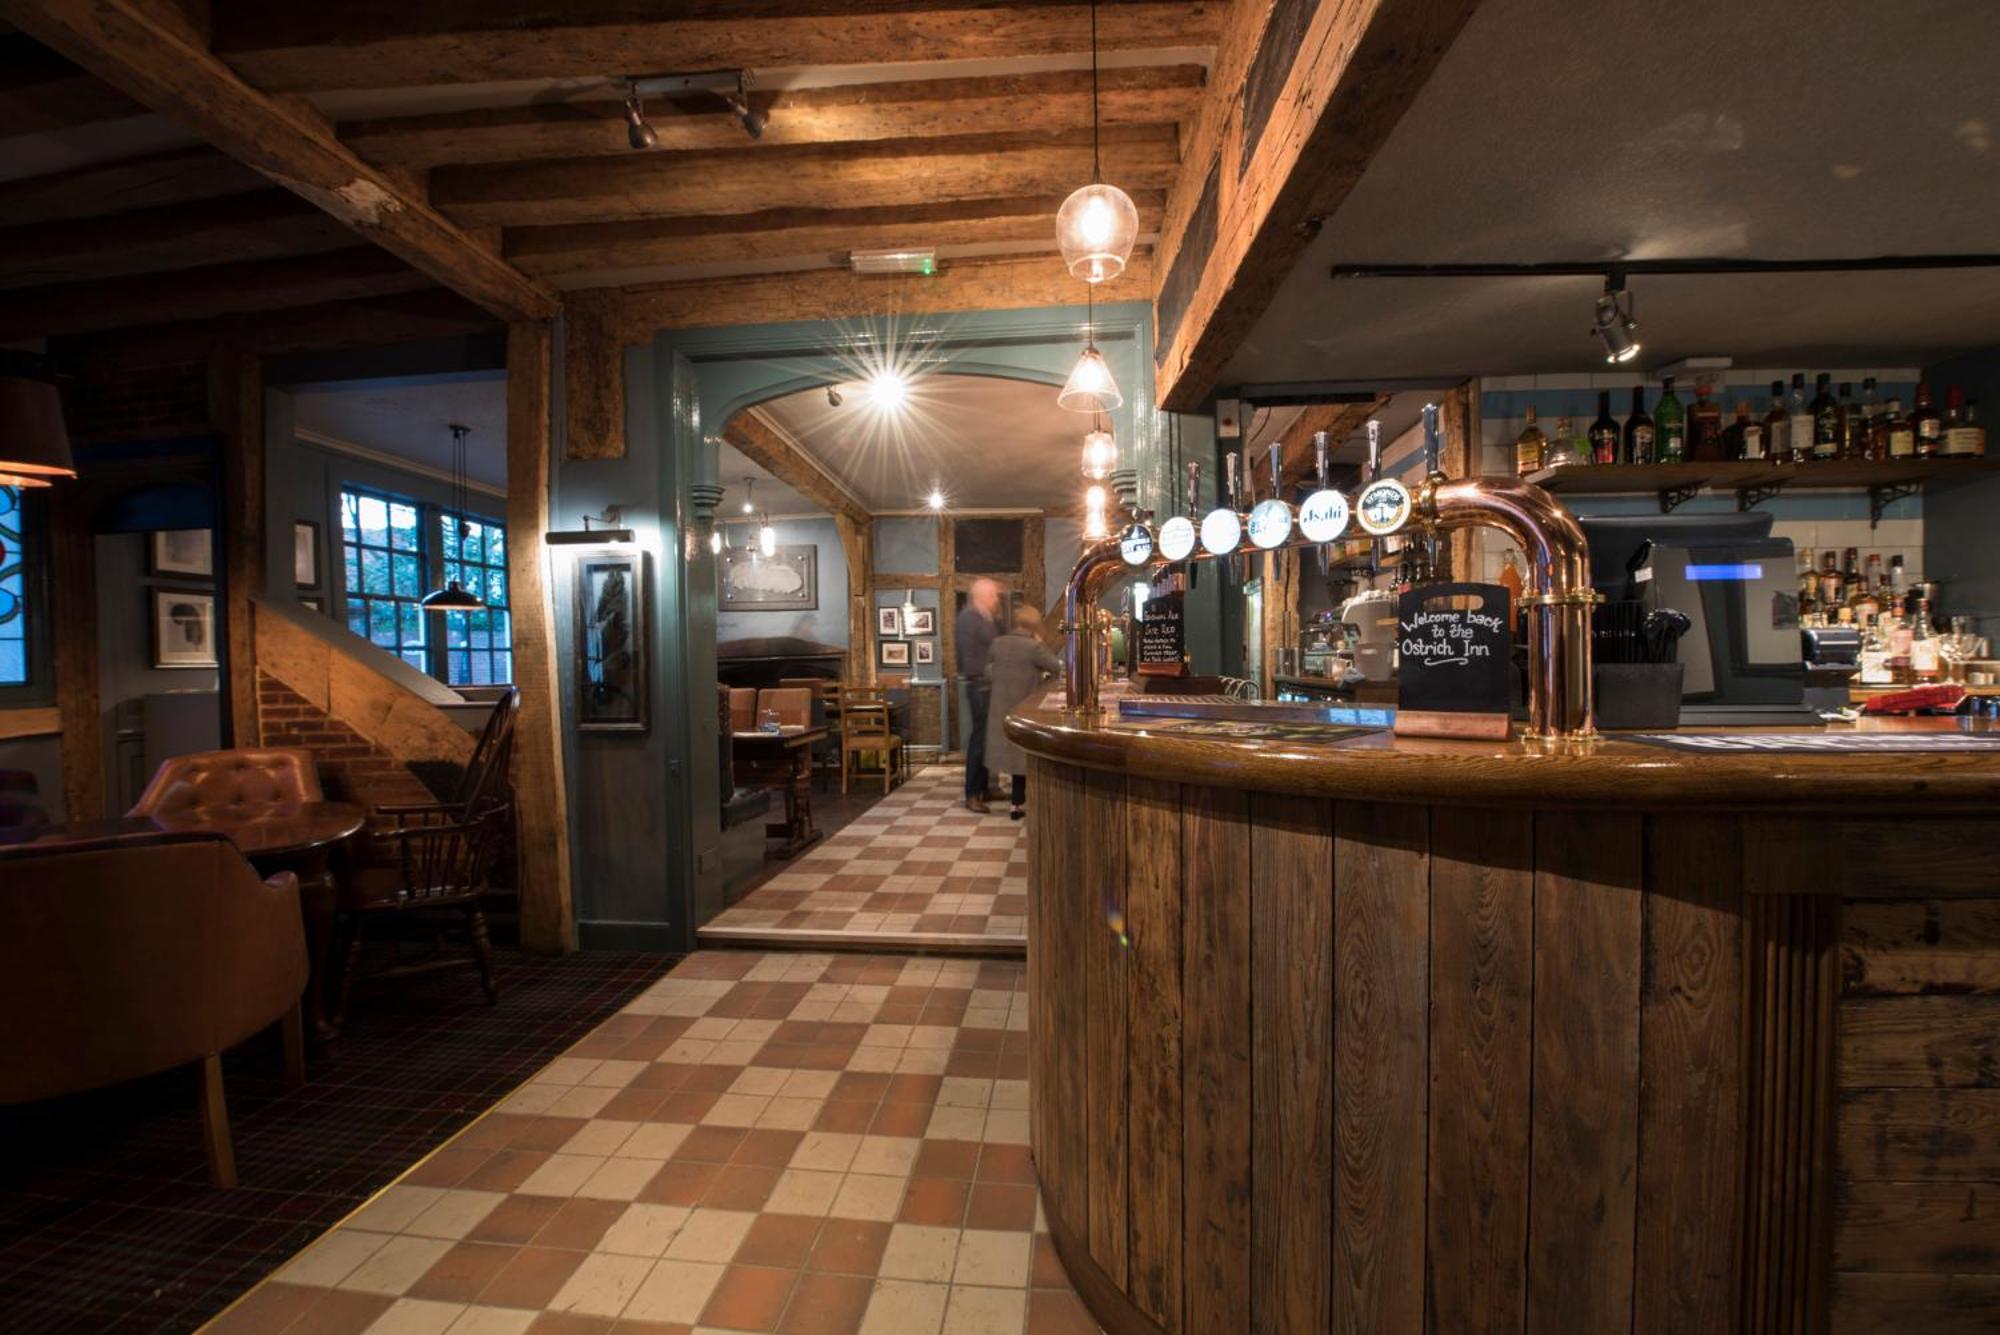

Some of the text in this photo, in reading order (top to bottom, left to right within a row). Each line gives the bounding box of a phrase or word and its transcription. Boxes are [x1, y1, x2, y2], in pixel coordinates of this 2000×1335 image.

[1401, 609, 1503, 633] Welcome back
[1432, 624, 1474, 639] to the
[1402, 638, 1490, 656] Ostrich Inn
